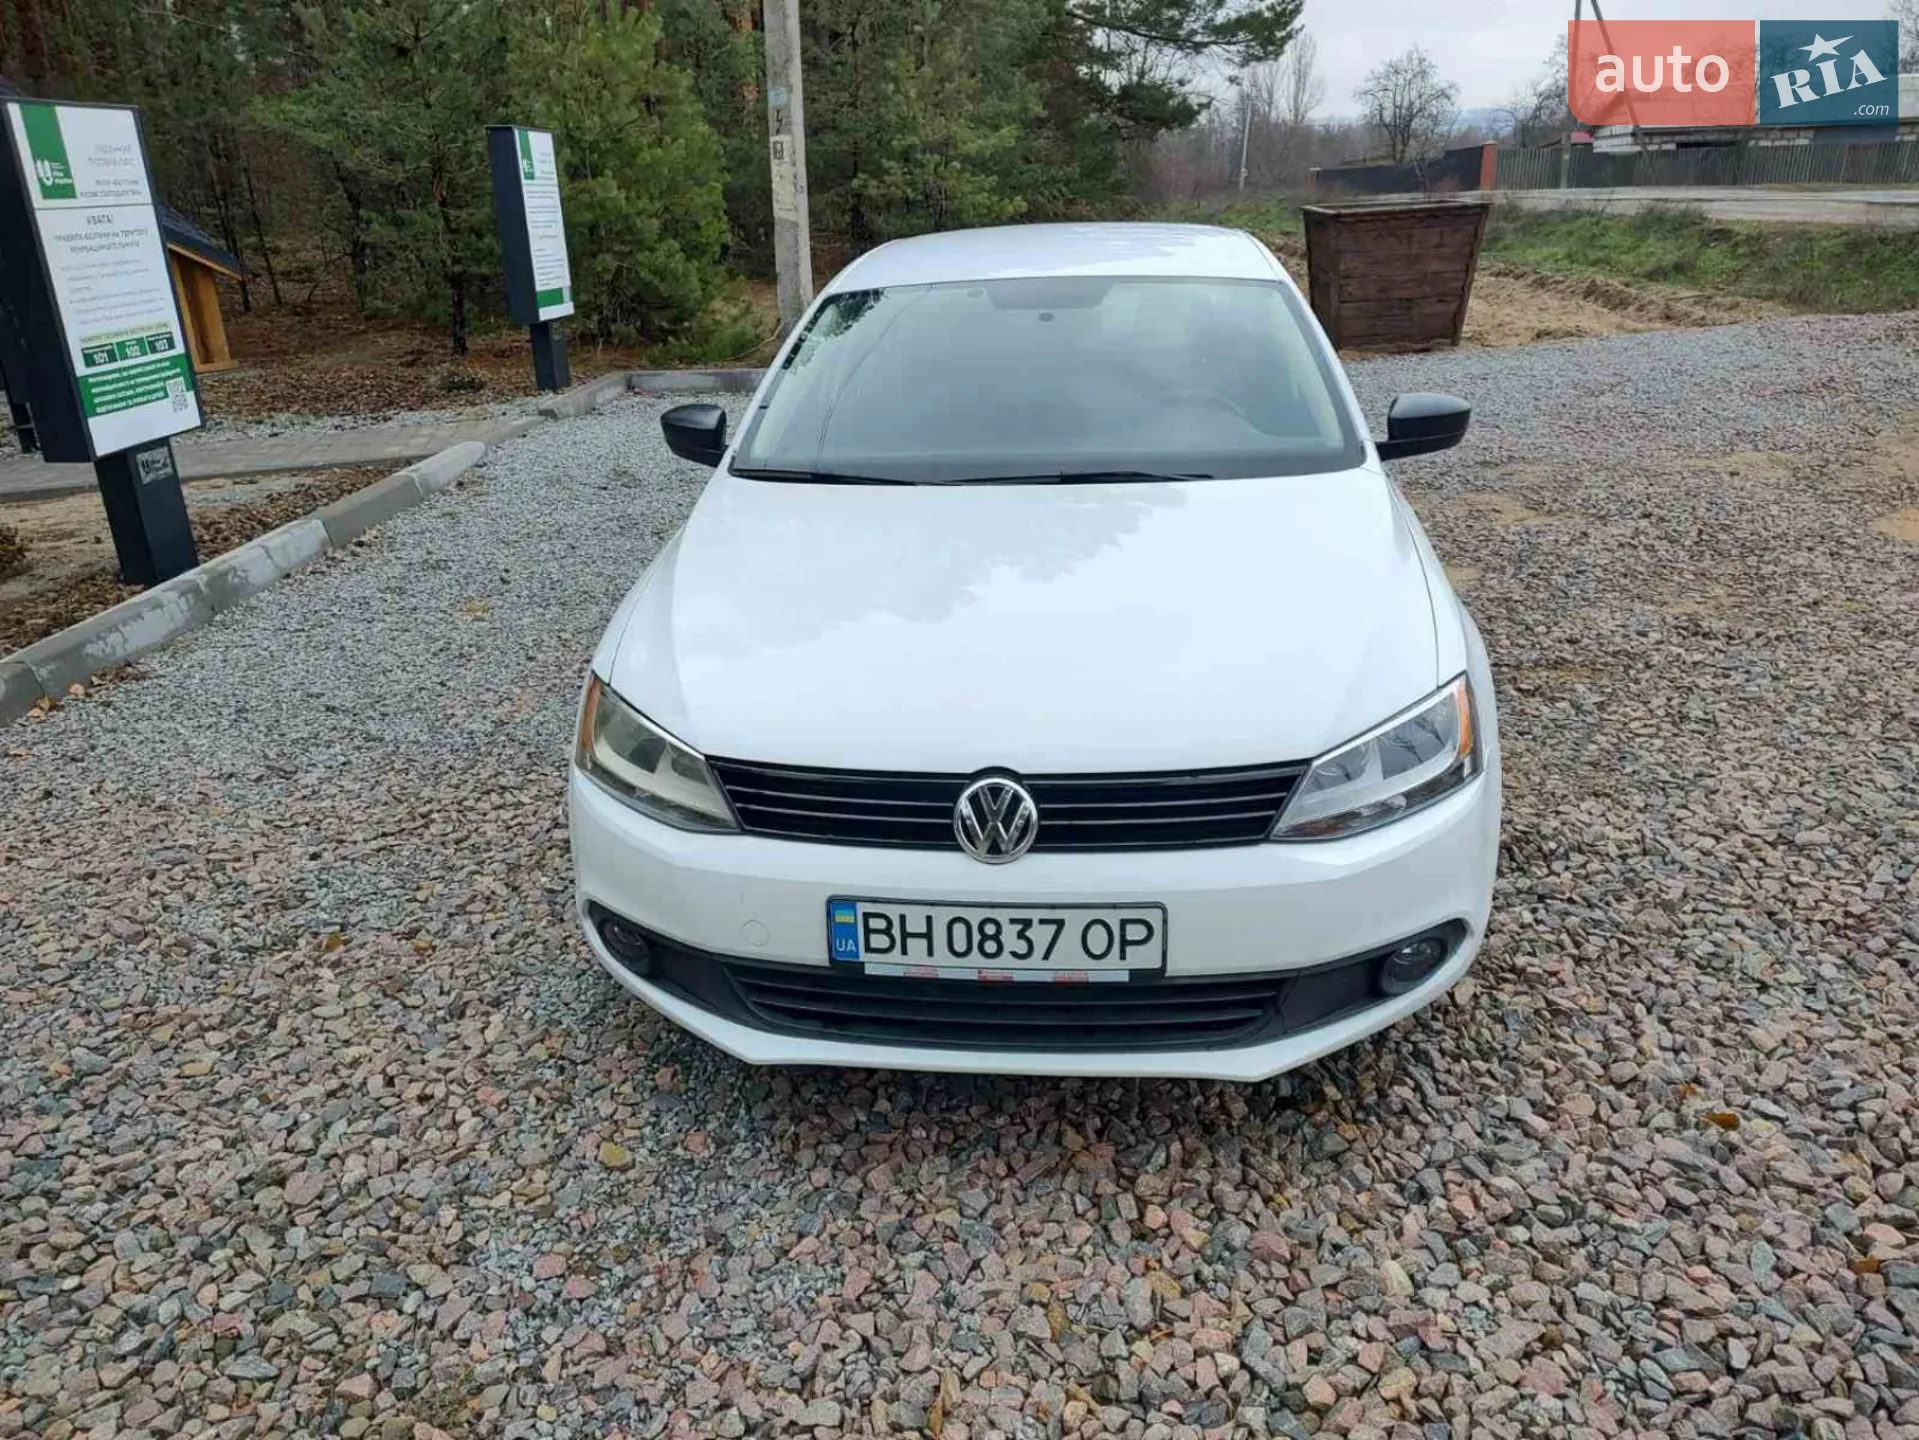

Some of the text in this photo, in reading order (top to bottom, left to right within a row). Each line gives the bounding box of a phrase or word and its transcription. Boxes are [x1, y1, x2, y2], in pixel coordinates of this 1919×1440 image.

[836, 938, 857, 954] UA
[862, 911, 1155, 961] BH 0837 OP
